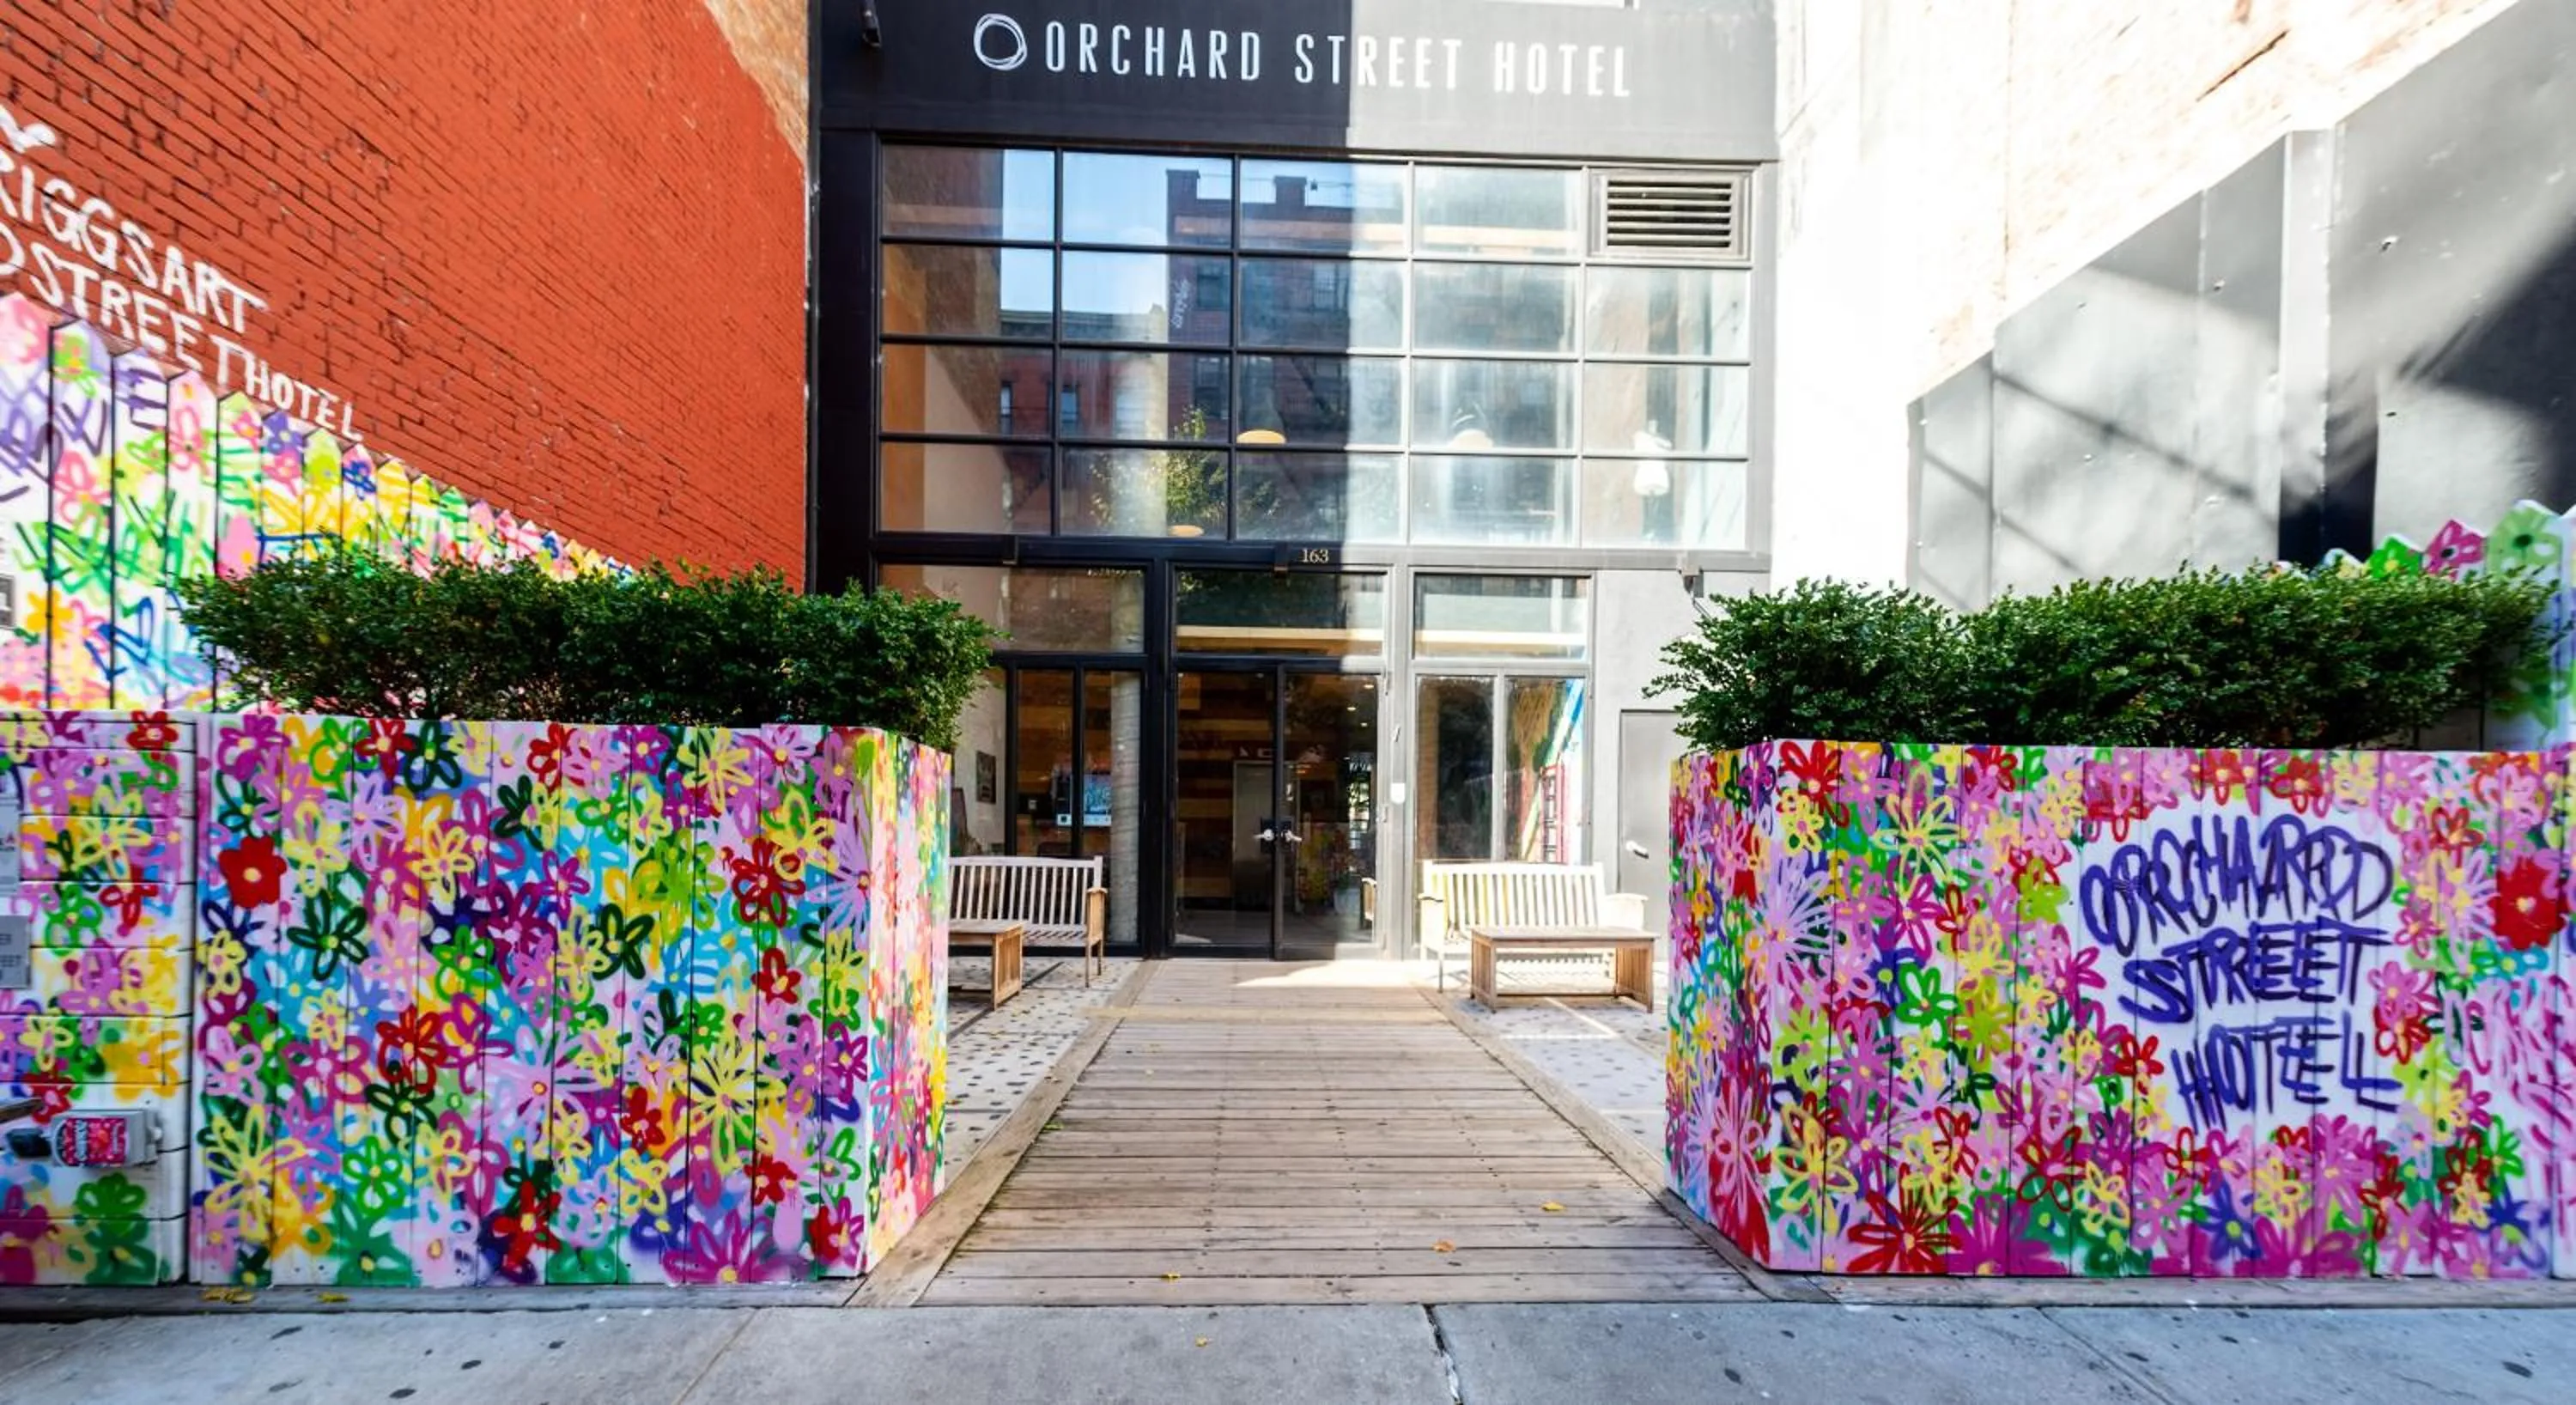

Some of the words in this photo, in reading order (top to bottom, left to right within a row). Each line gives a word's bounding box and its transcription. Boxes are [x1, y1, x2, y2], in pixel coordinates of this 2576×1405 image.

[1046, 21, 1260, 81] ORCHARD
[1294, 33, 1462, 90] STREET
[1495, 41, 1630, 96] HOTEL
[29, 241, 250, 385] STREET
[246, 354, 364, 441] HOTEL
[1303, 547, 1329, 563] 163
[2080, 814, 2394, 957] ORCHARD
[2118, 915, 2394, 1024] STREET
[2170, 1011, 2403, 1135] HOTEL
